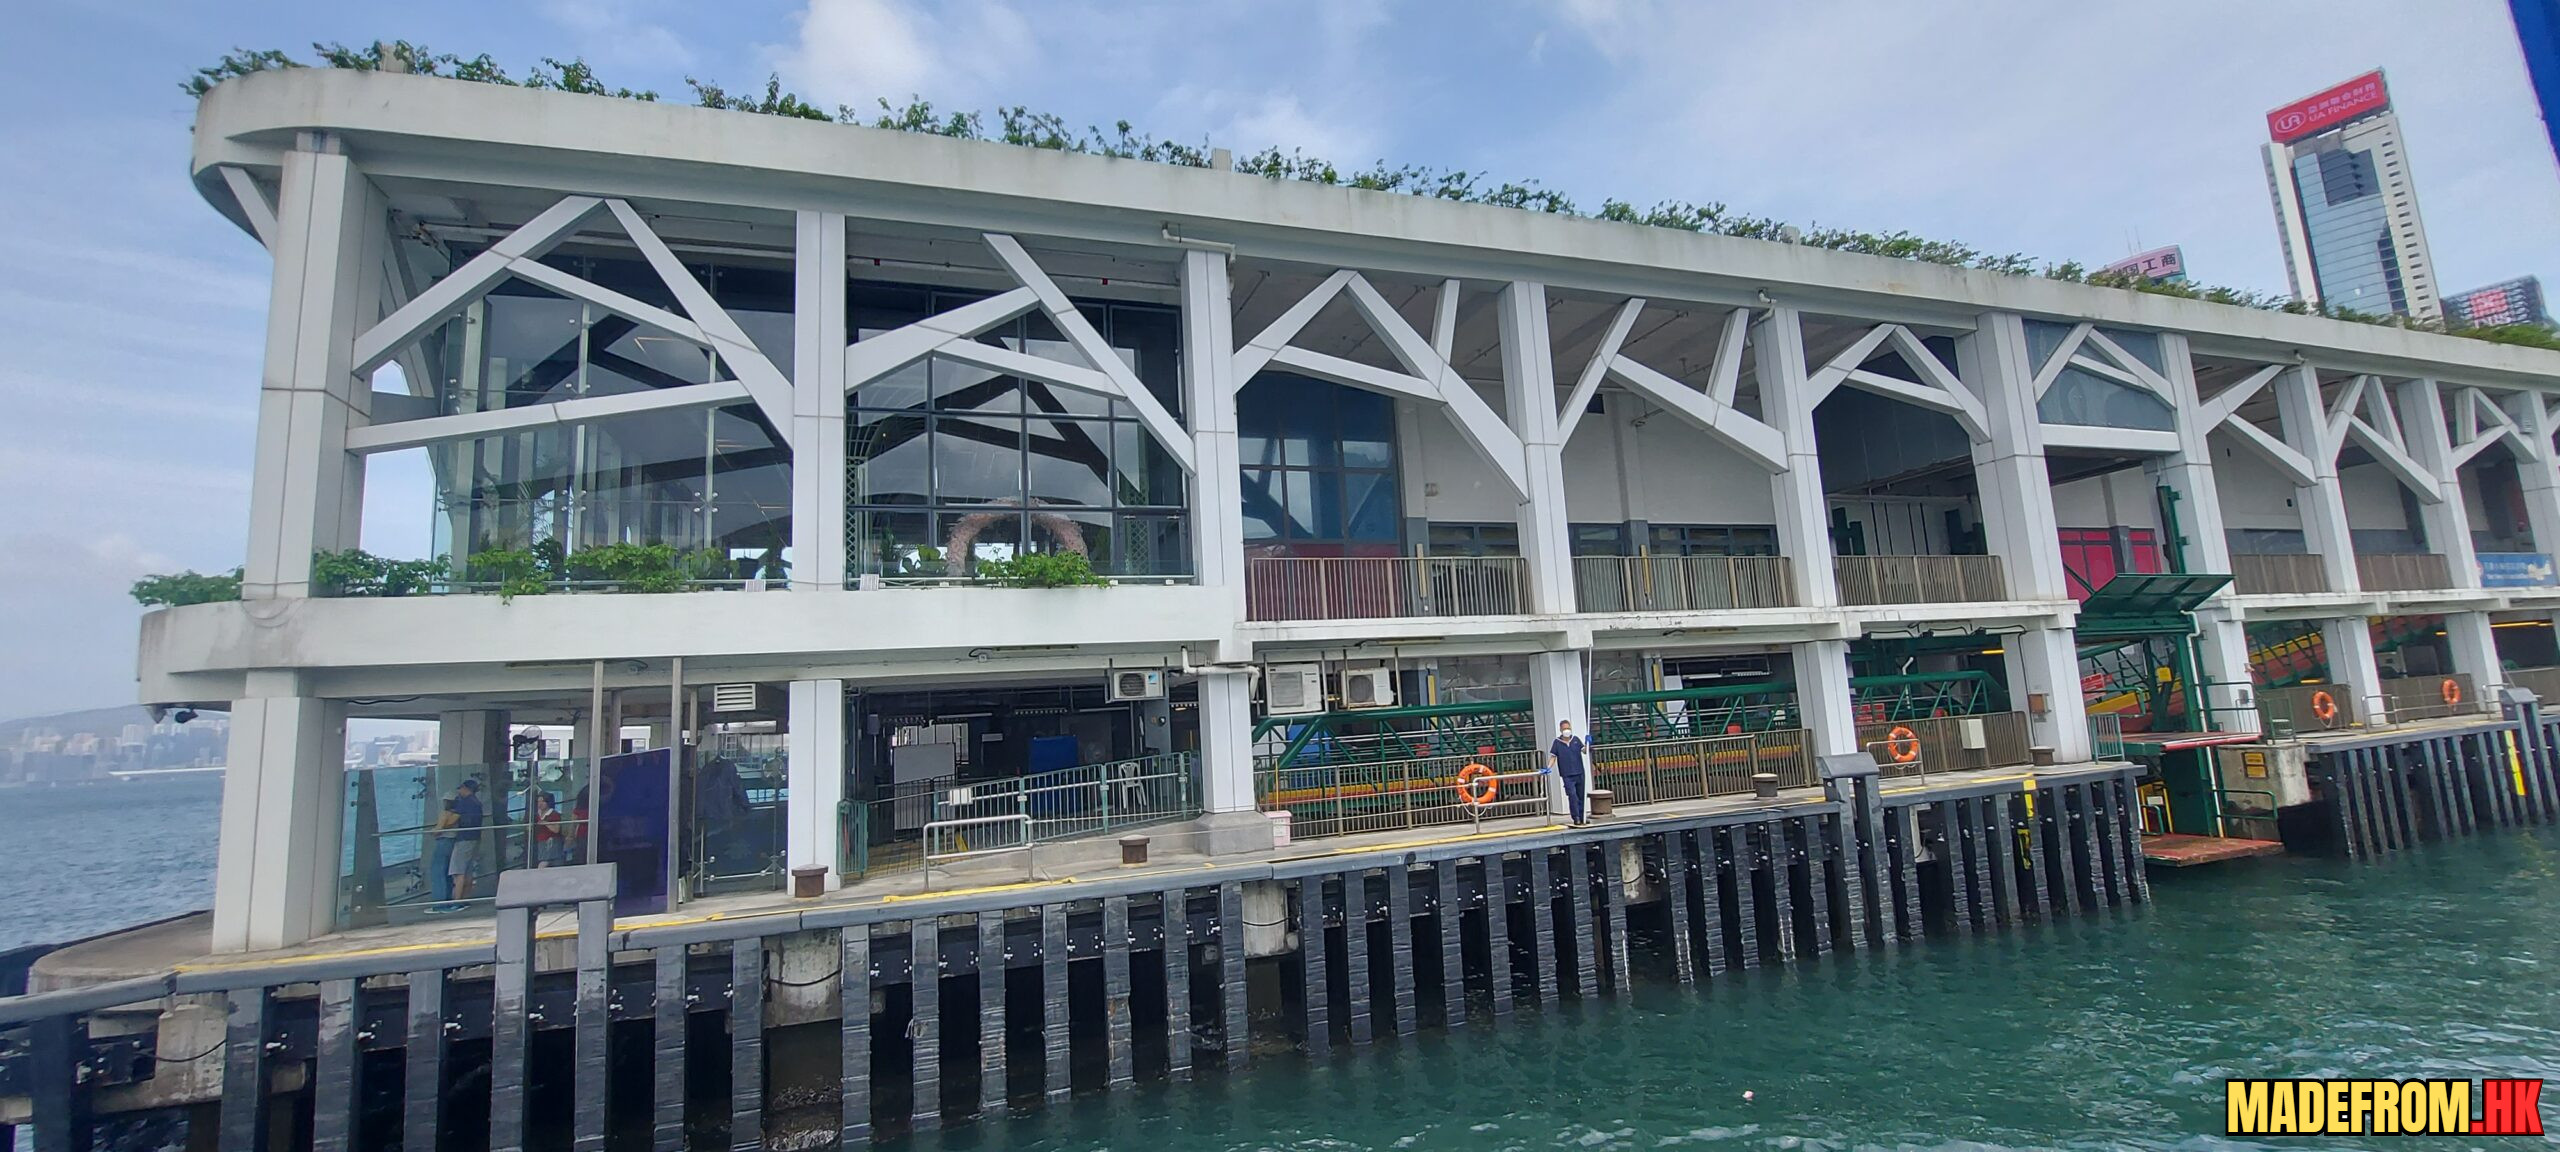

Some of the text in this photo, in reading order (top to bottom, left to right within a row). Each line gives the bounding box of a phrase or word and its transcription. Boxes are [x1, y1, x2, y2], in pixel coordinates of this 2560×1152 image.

[2309, 91, 2378, 122] UA FINANCE
[2113, 253, 2177, 277] 国工商
